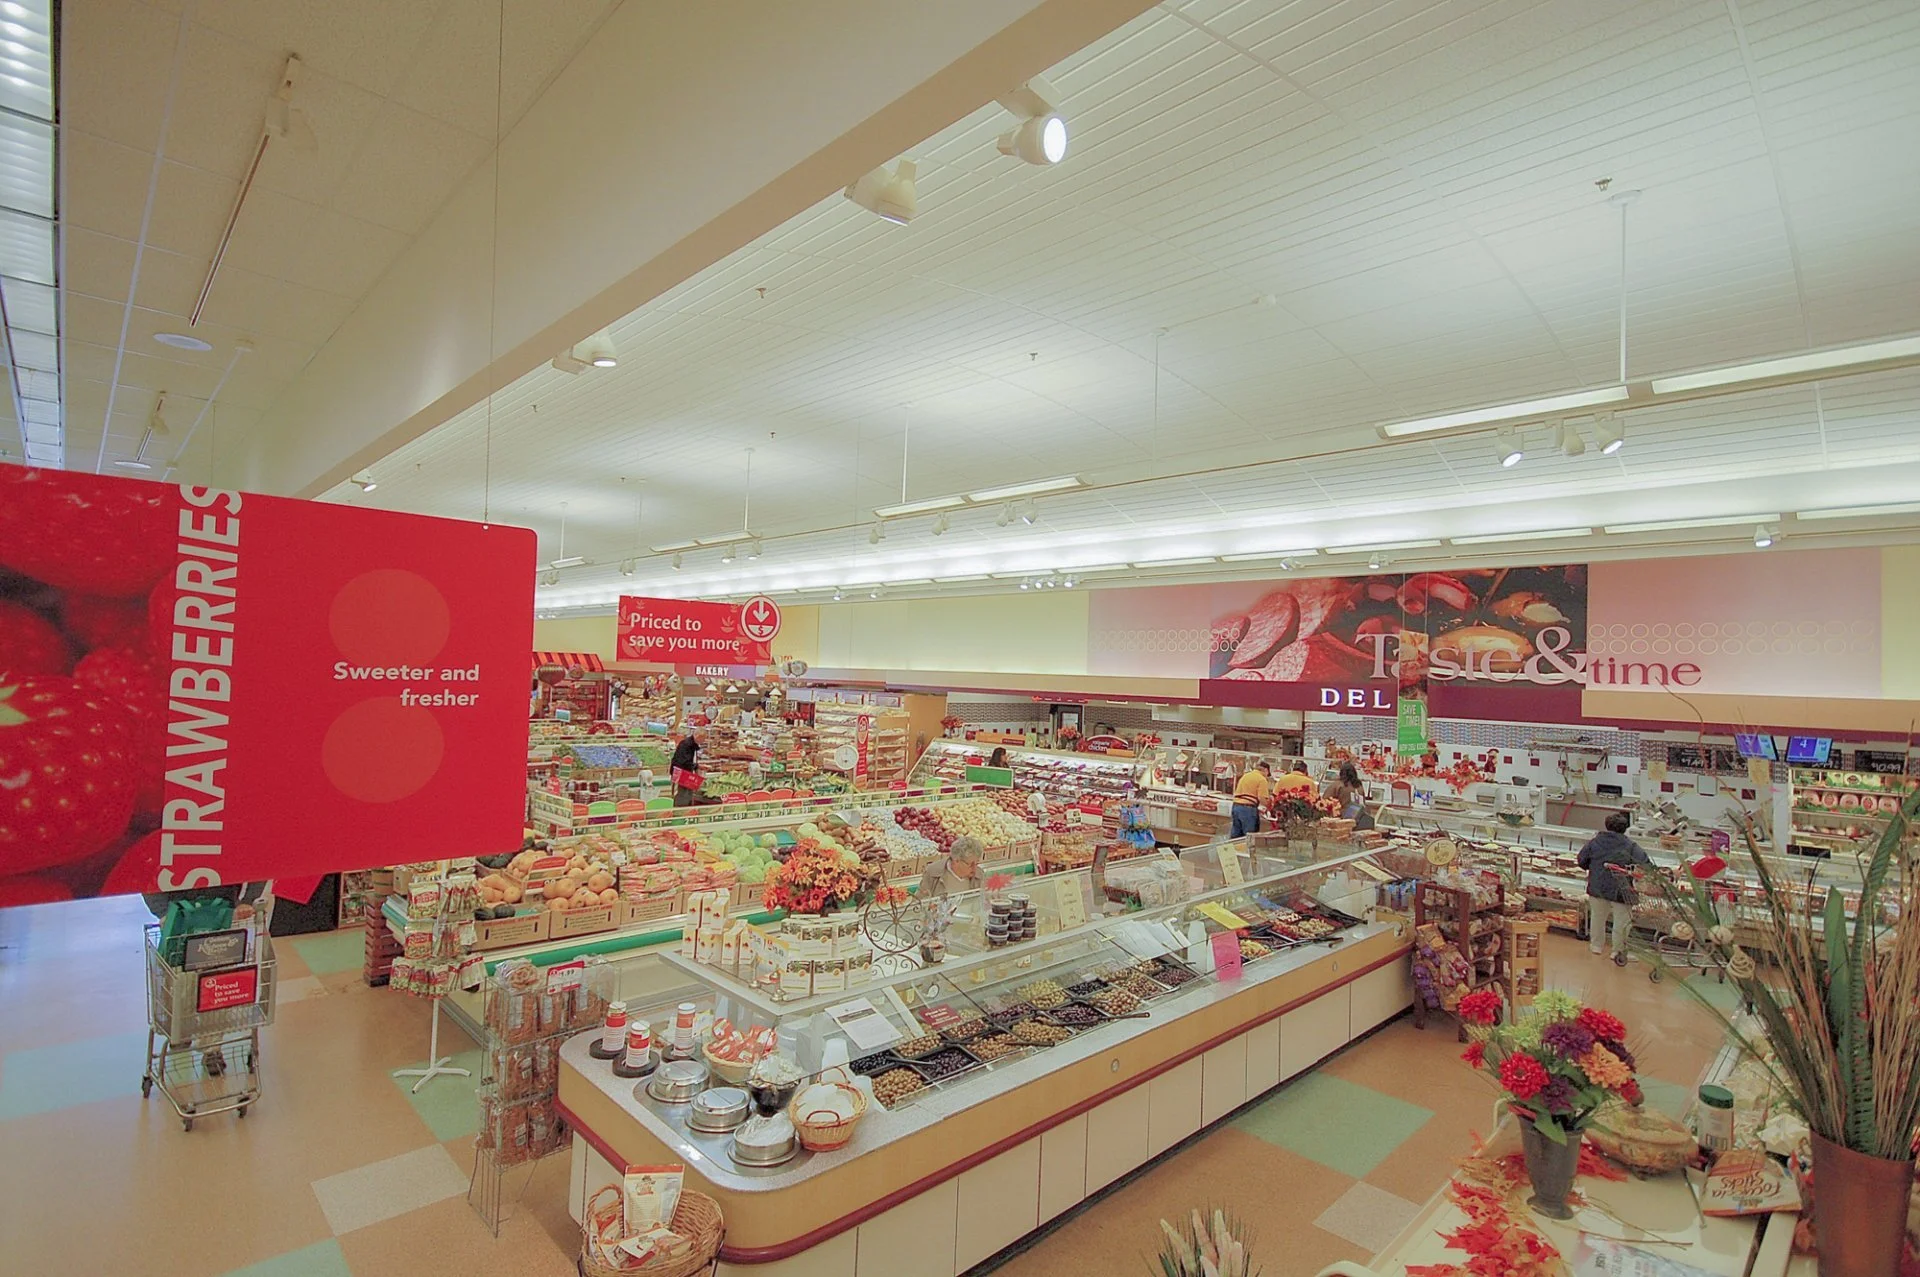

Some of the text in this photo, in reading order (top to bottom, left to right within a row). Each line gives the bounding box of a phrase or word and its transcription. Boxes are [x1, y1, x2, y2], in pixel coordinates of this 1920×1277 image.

[630, 613, 702, 632] Priced to
[629, 636, 740, 654] save you more
[333, 661, 480, 682] Sweeter and
[695, 665, 729, 677] BAKERY
[1590, 657, 1702, 686] time
[157, 484, 242, 892] STRAWBERRIES
[400, 688, 479, 707] fresher
[1319, 687, 1392, 709] DEL
[214, 982, 238, 990] Priced
[214, 996, 229, 1004] you
